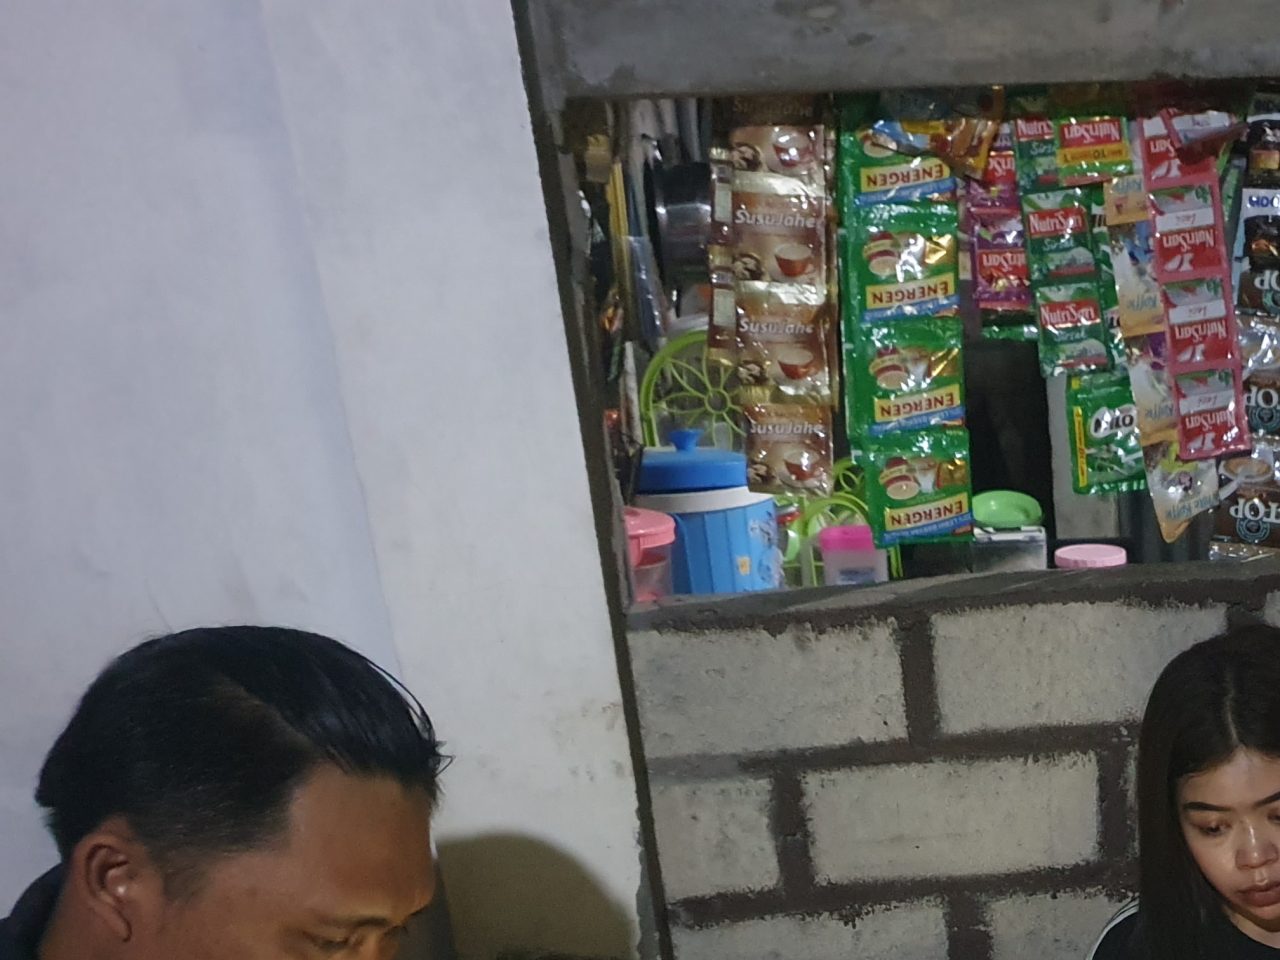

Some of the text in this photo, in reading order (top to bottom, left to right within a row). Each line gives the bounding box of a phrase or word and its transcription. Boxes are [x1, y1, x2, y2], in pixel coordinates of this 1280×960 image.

[1063, 121, 1120, 144] NutriSari
[866, 163, 944, 187] ENERGEN
[1162, 229, 1214, 253] NutriSari
[870, 280, 950, 305] ENERGEN
[1039, 306, 1098, 326] NutriSari
[1174, 319, 1228, 342] NutriSari
[880, 391, 955, 417] ENERGEN
[1184, 409, 1236, 430] NutriSari
[890, 500, 964, 526] ENERGEN
